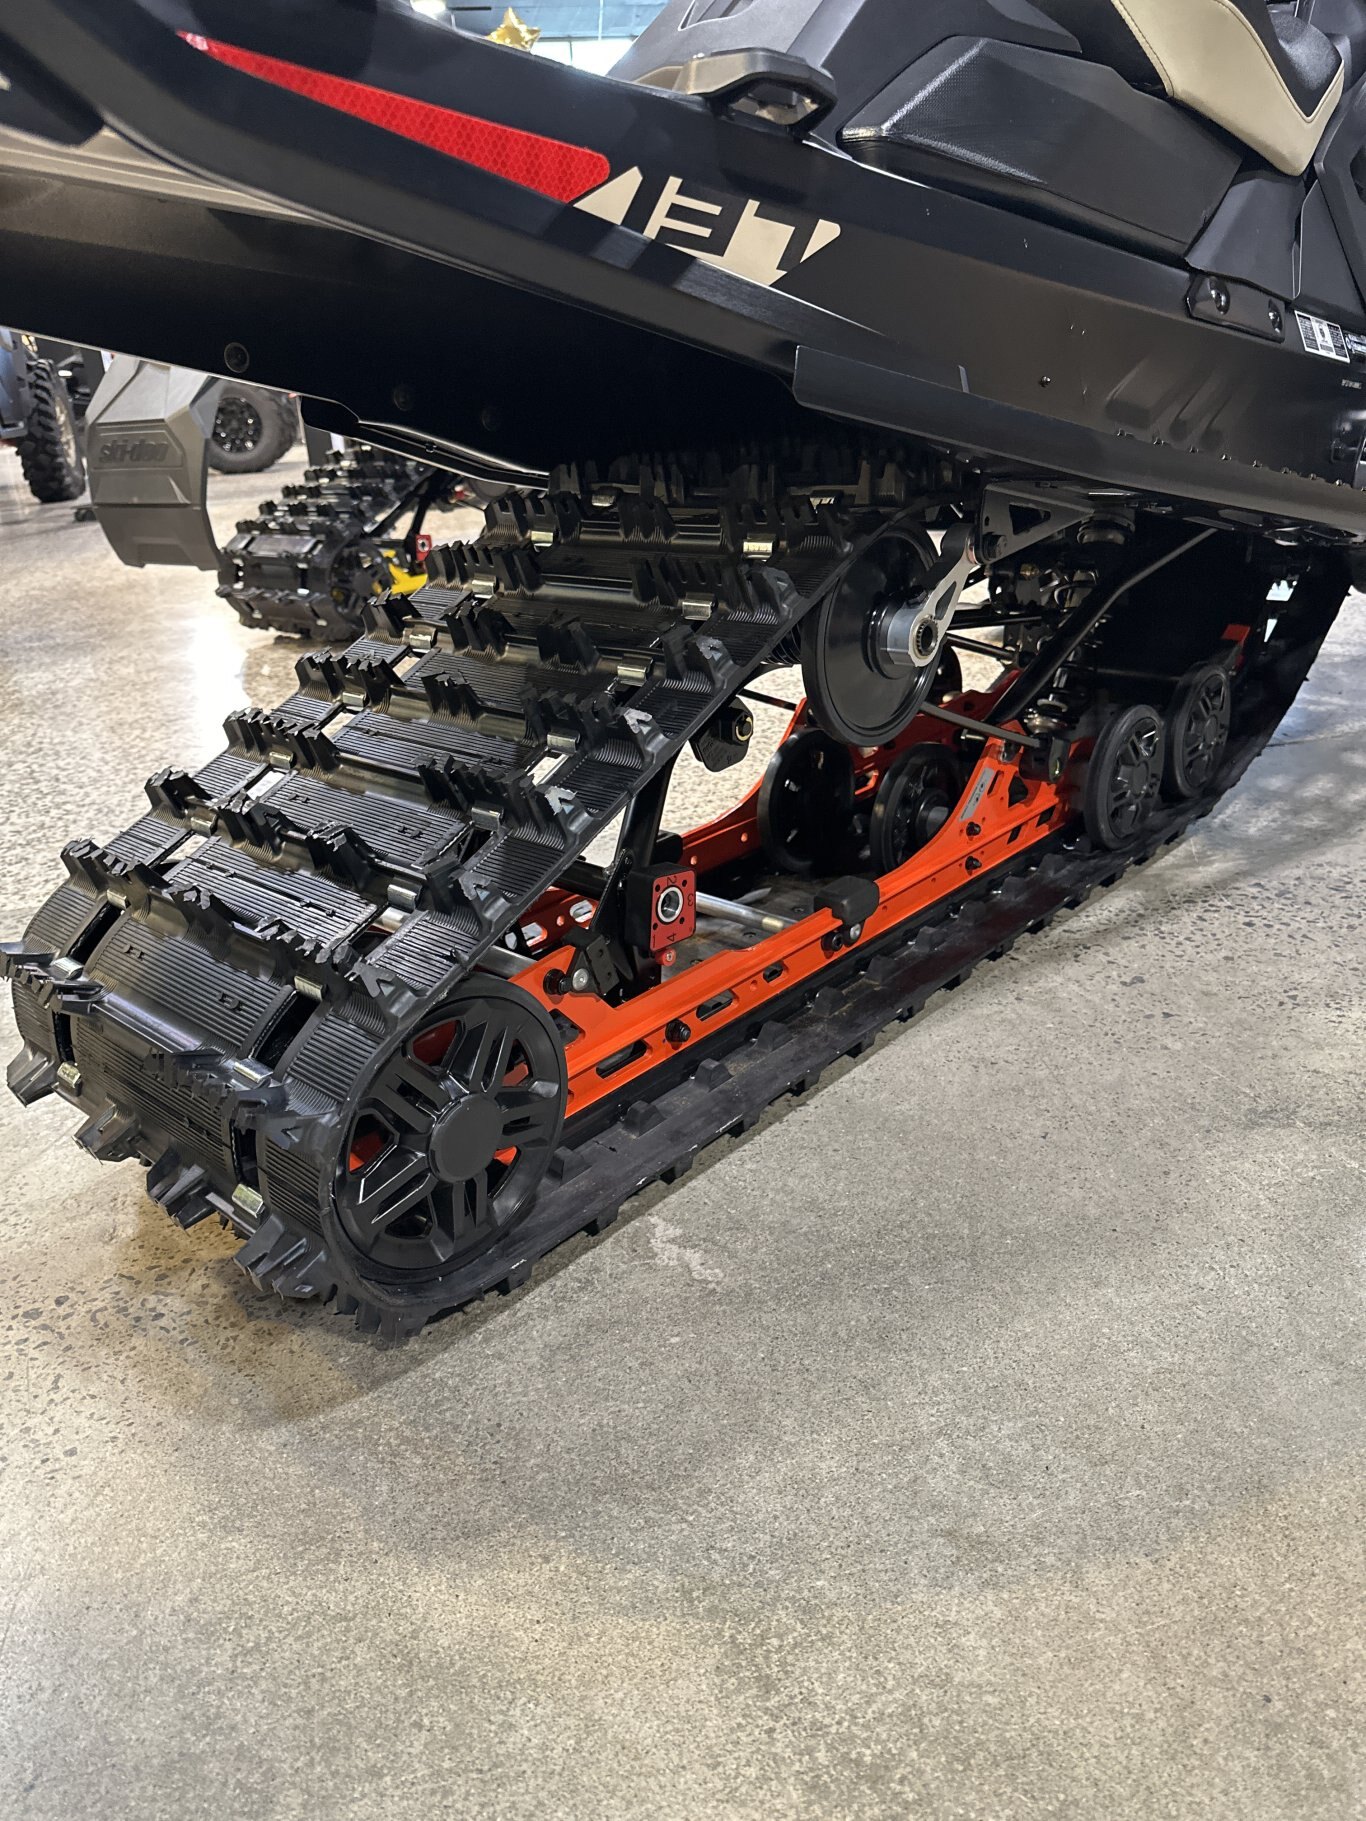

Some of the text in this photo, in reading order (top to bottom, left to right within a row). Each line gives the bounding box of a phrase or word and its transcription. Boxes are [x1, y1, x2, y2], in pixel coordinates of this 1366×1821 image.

[667, 875, 677, 886] 2
[687, 893, 694, 906] 3
[666, 933, 676, 942] 4
